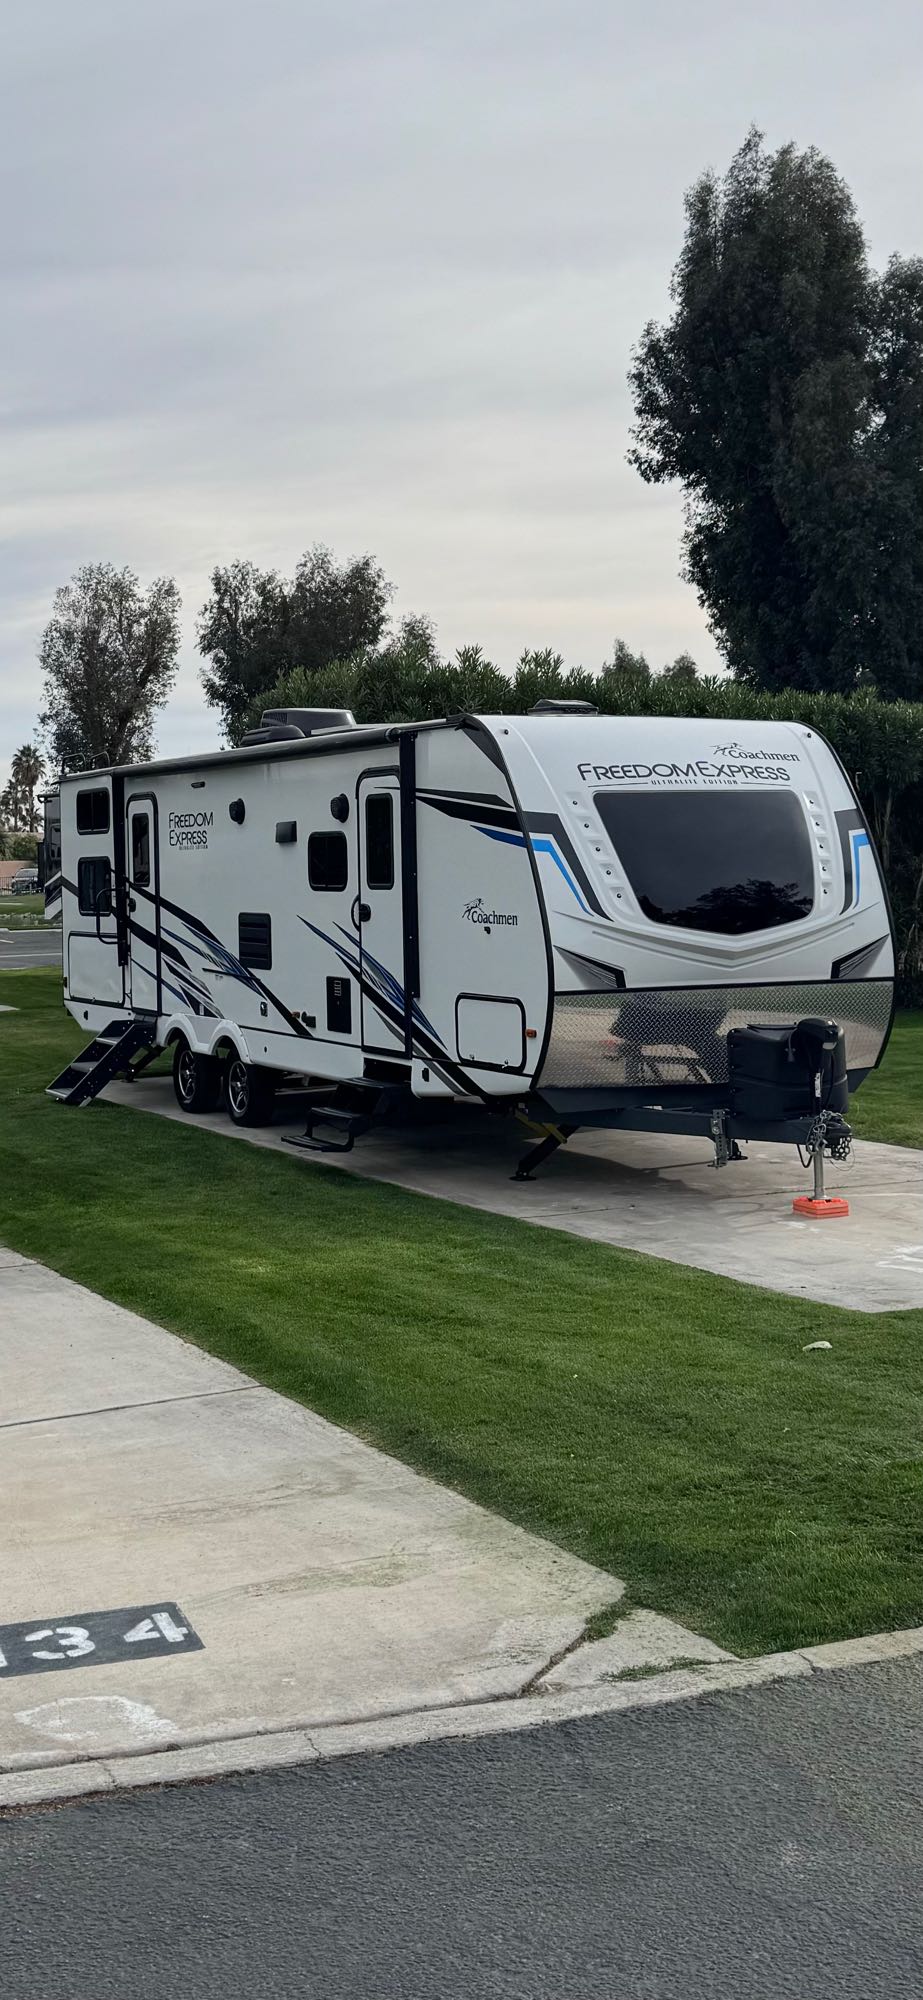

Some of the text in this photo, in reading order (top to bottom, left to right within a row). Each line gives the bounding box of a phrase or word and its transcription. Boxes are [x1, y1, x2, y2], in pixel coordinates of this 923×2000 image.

[728, 745, 800, 761] Coachmen
[169, 812, 213, 829] FREEDOM
[169, 829, 208, 846] EXPRESS
[471, 910, 518, 926] Coachmen
[0, 1611, 189, 1668] 34
